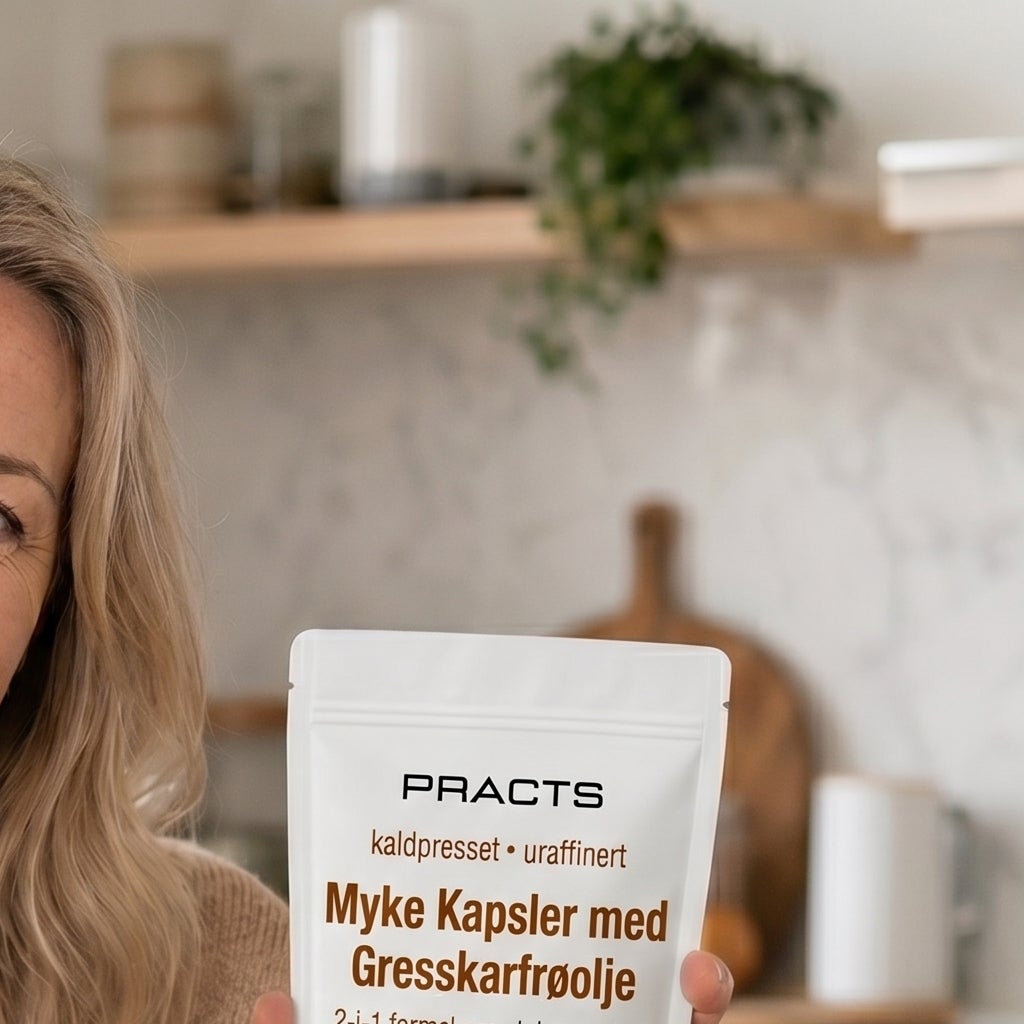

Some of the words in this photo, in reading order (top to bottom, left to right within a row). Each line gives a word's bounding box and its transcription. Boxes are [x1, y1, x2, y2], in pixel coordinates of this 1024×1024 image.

[401, 773, 604, 809] PRACTS
[371, 828, 501, 864] kaldpresset
[523, 839, 628, 869] uraffinert
[325, 881, 425, 936] Myke
[437, 887, 579, 943] Kapsler
[588, 899, 669, 943] med
[351, 944, 637, 1010] Gresskarfrøolje
